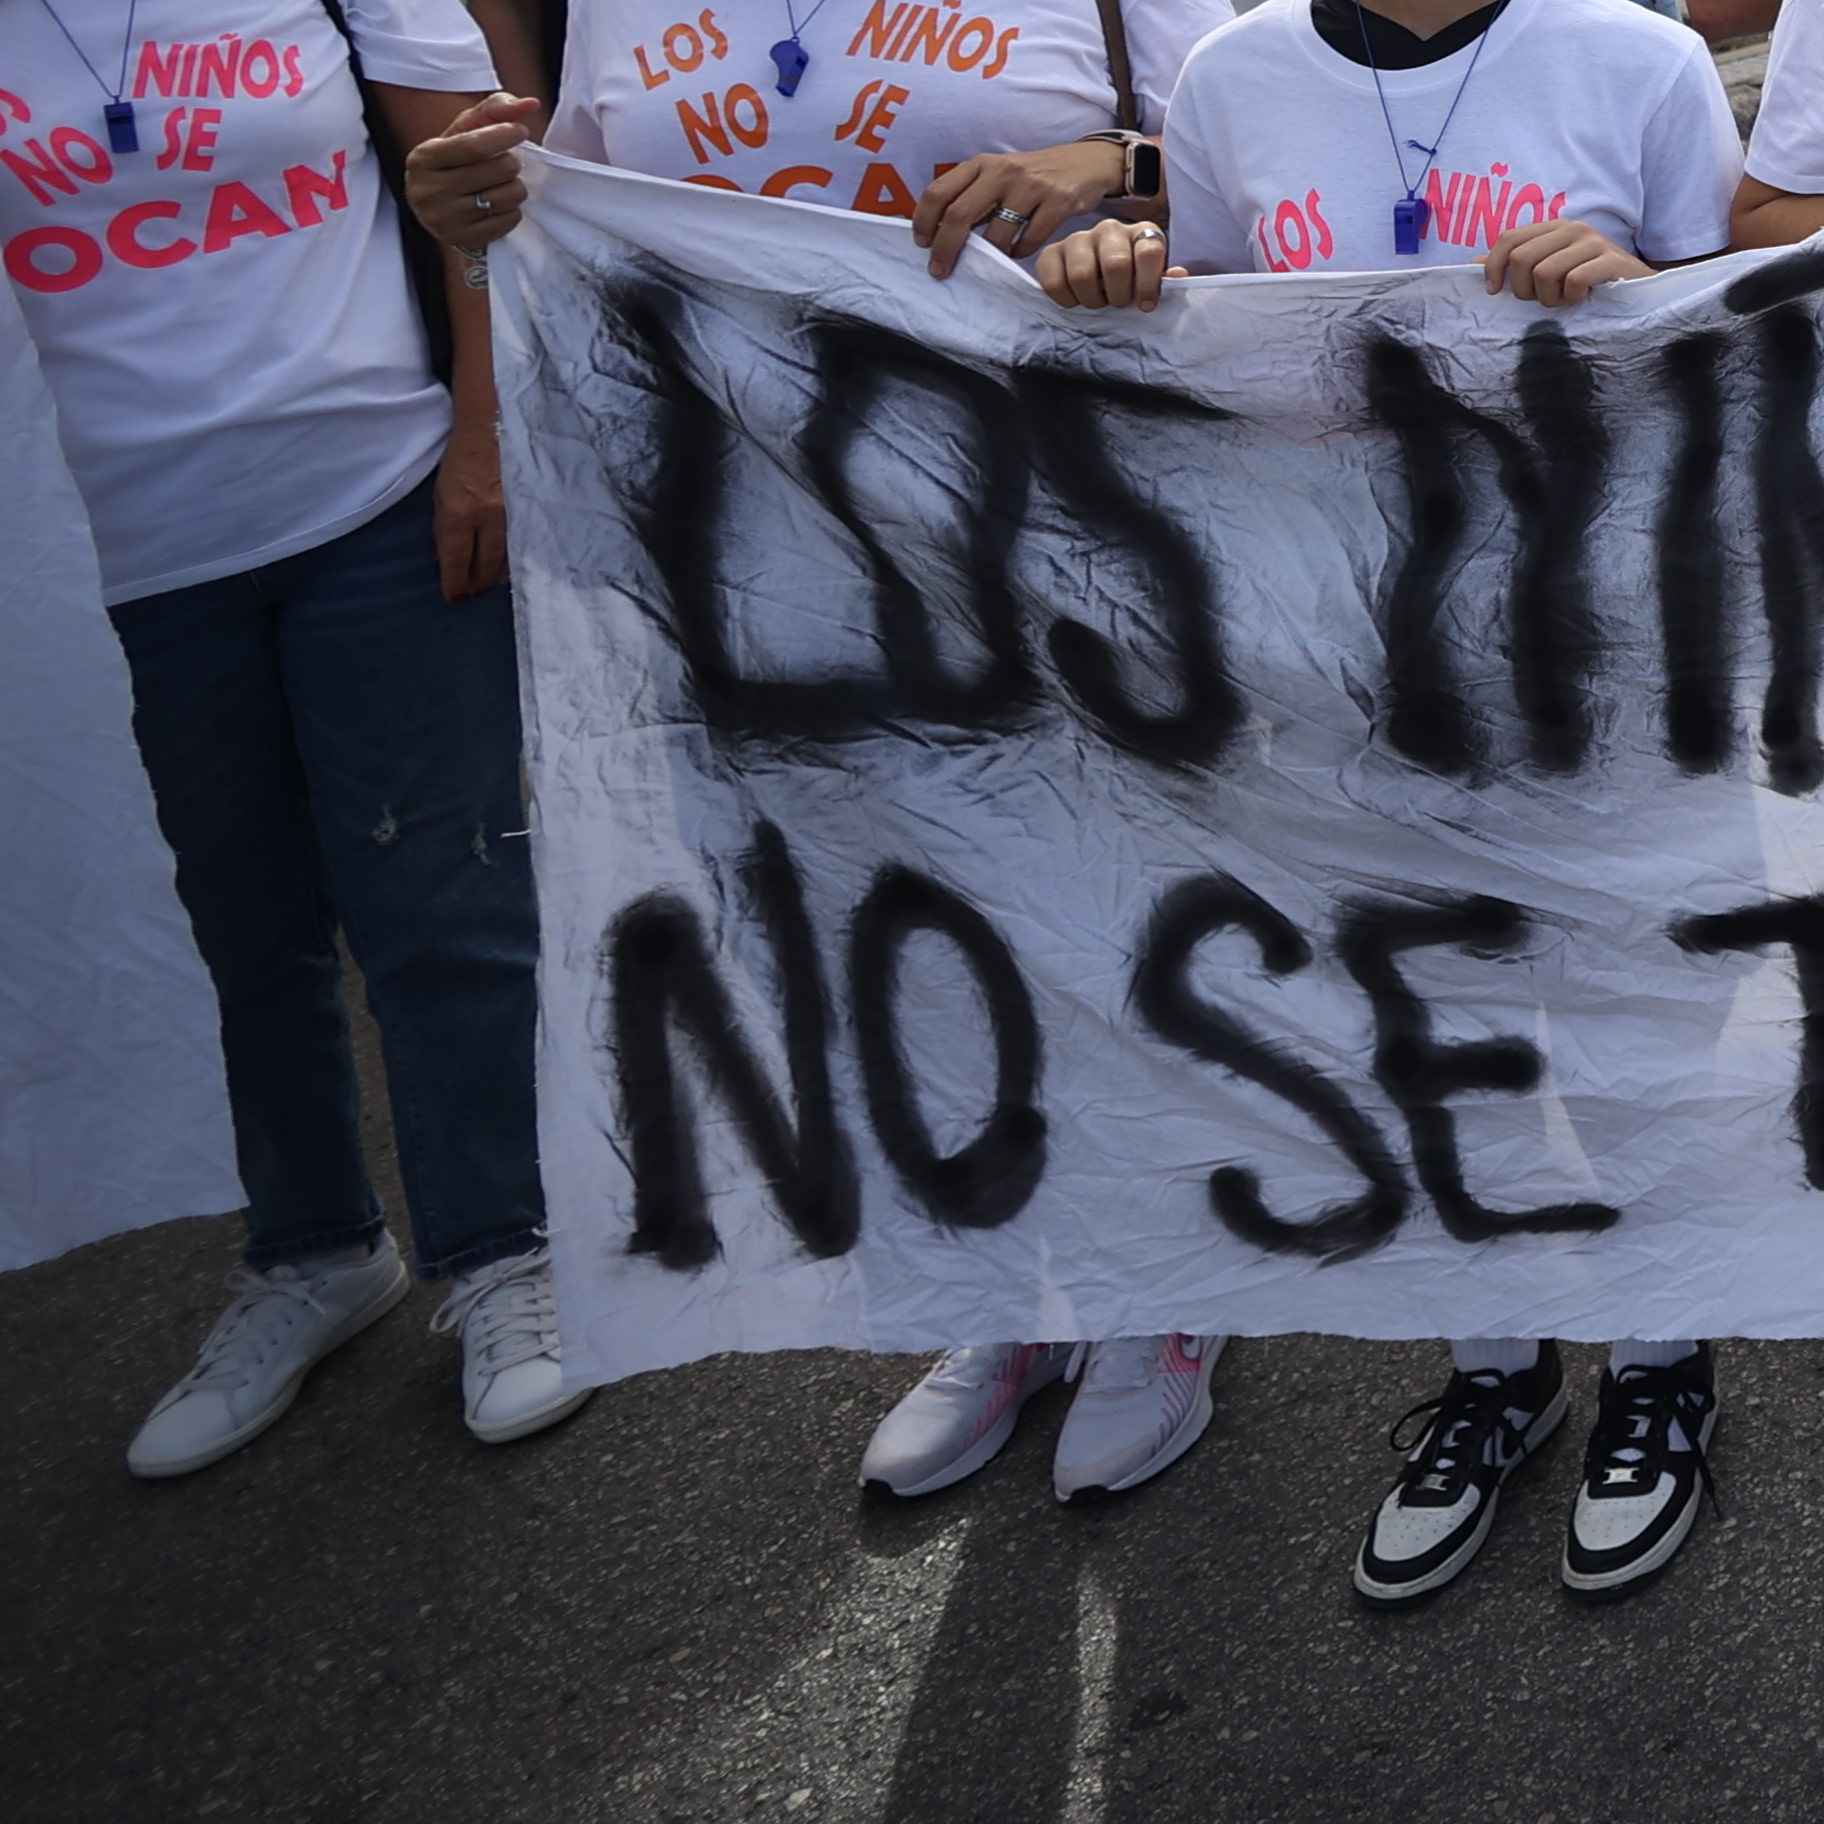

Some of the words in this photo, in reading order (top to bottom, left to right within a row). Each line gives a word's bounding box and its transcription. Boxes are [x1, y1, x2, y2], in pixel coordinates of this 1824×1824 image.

[132, 33, 304, 99] NIÑOS
[633, 7, 729, 91] LOS
[0, 127, 114, 207] NO
[155, 105, 223, 172] SE
[674, 82, 769, 165] NO
[833, 78, 911, 154] SE
[3, 149, 349, 294] OCAN
[1257, 187, 1333, 273] LOS
[590, 254, 1238, 768] LOS
[602, 821, 1050, 1271] NO
[1130, 871, 1620, 1258] SE
